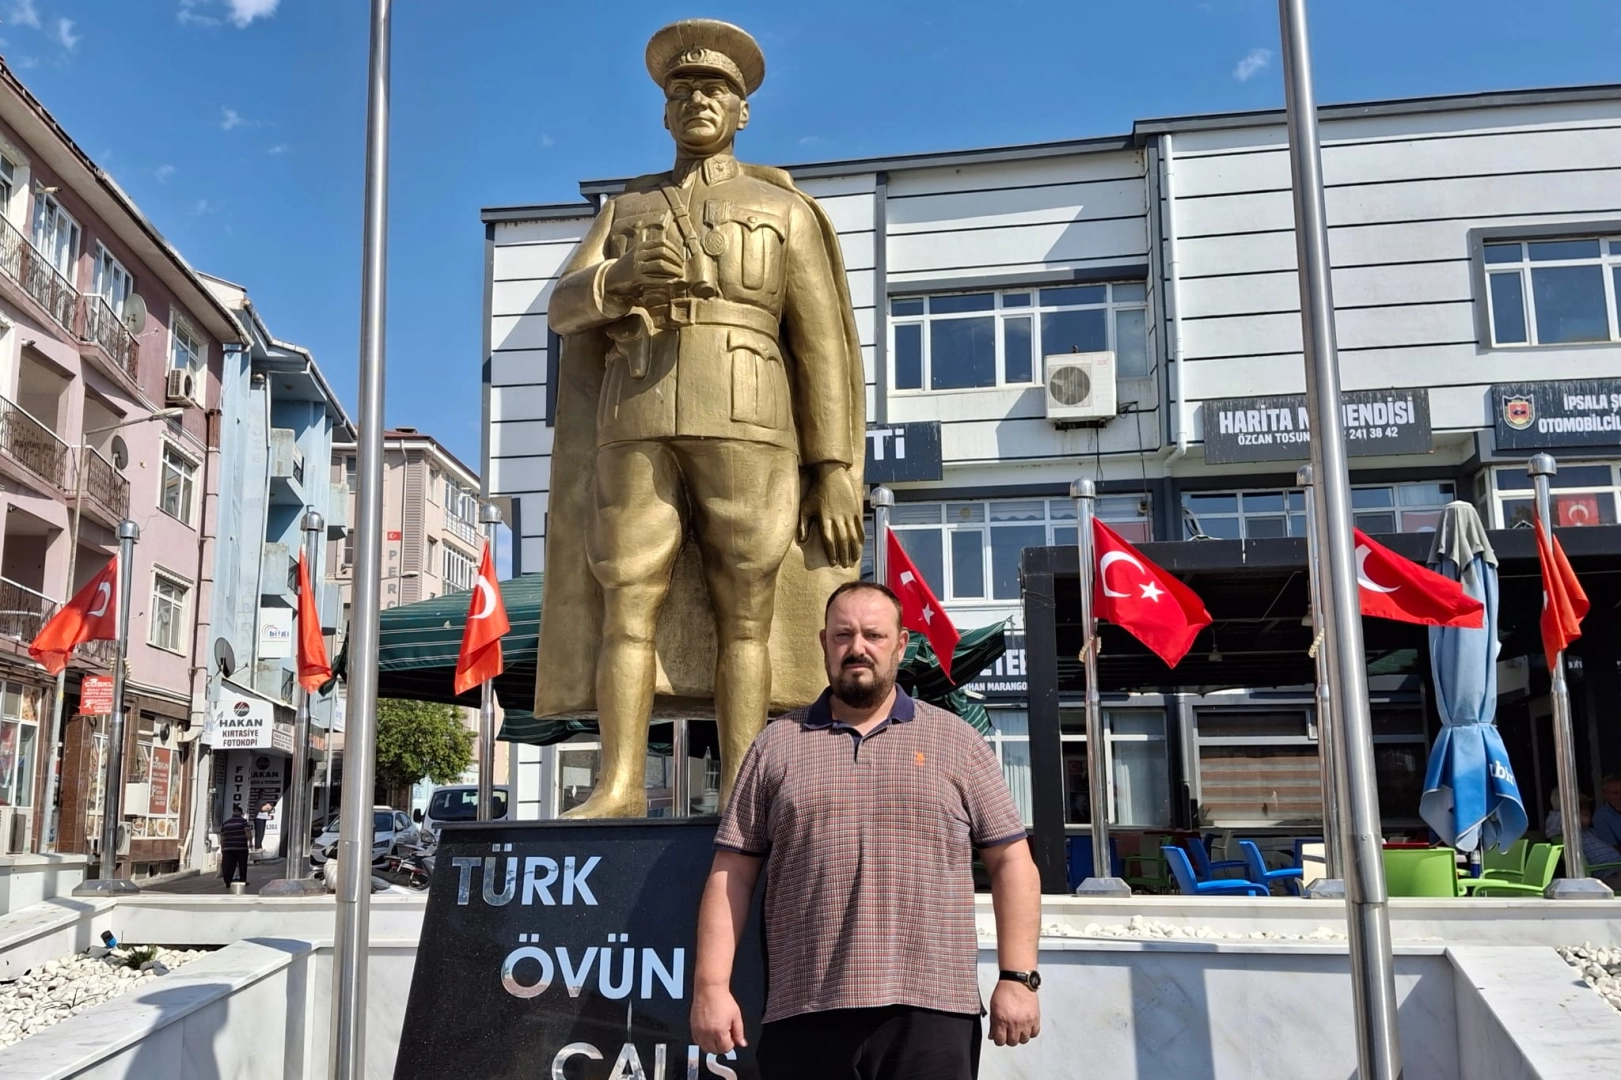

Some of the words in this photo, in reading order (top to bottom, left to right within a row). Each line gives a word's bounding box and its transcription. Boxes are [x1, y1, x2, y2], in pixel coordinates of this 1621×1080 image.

[1563, 393, 1608, 411] İPSALA
[1219, 405, 1293, 434] HARİTA
[1237, 433, 1273, 446] ÖZCAN
[1274, 430, 1311, 444] TOSUN
[1349, 428, 1367, 440] 241
[1369, 427, 1383, 439] 38
[1385, 426, 1398, 438] 42
[219, 718, 263, 728] HAKAN
[222, 728, 259, 738] KIRTASİYE
[223, 738, 258, 747] FOTOKOPİ
[452, 843, 602, 906] TÜRK
[501, 933, 685, 1000] ÖVÜN
